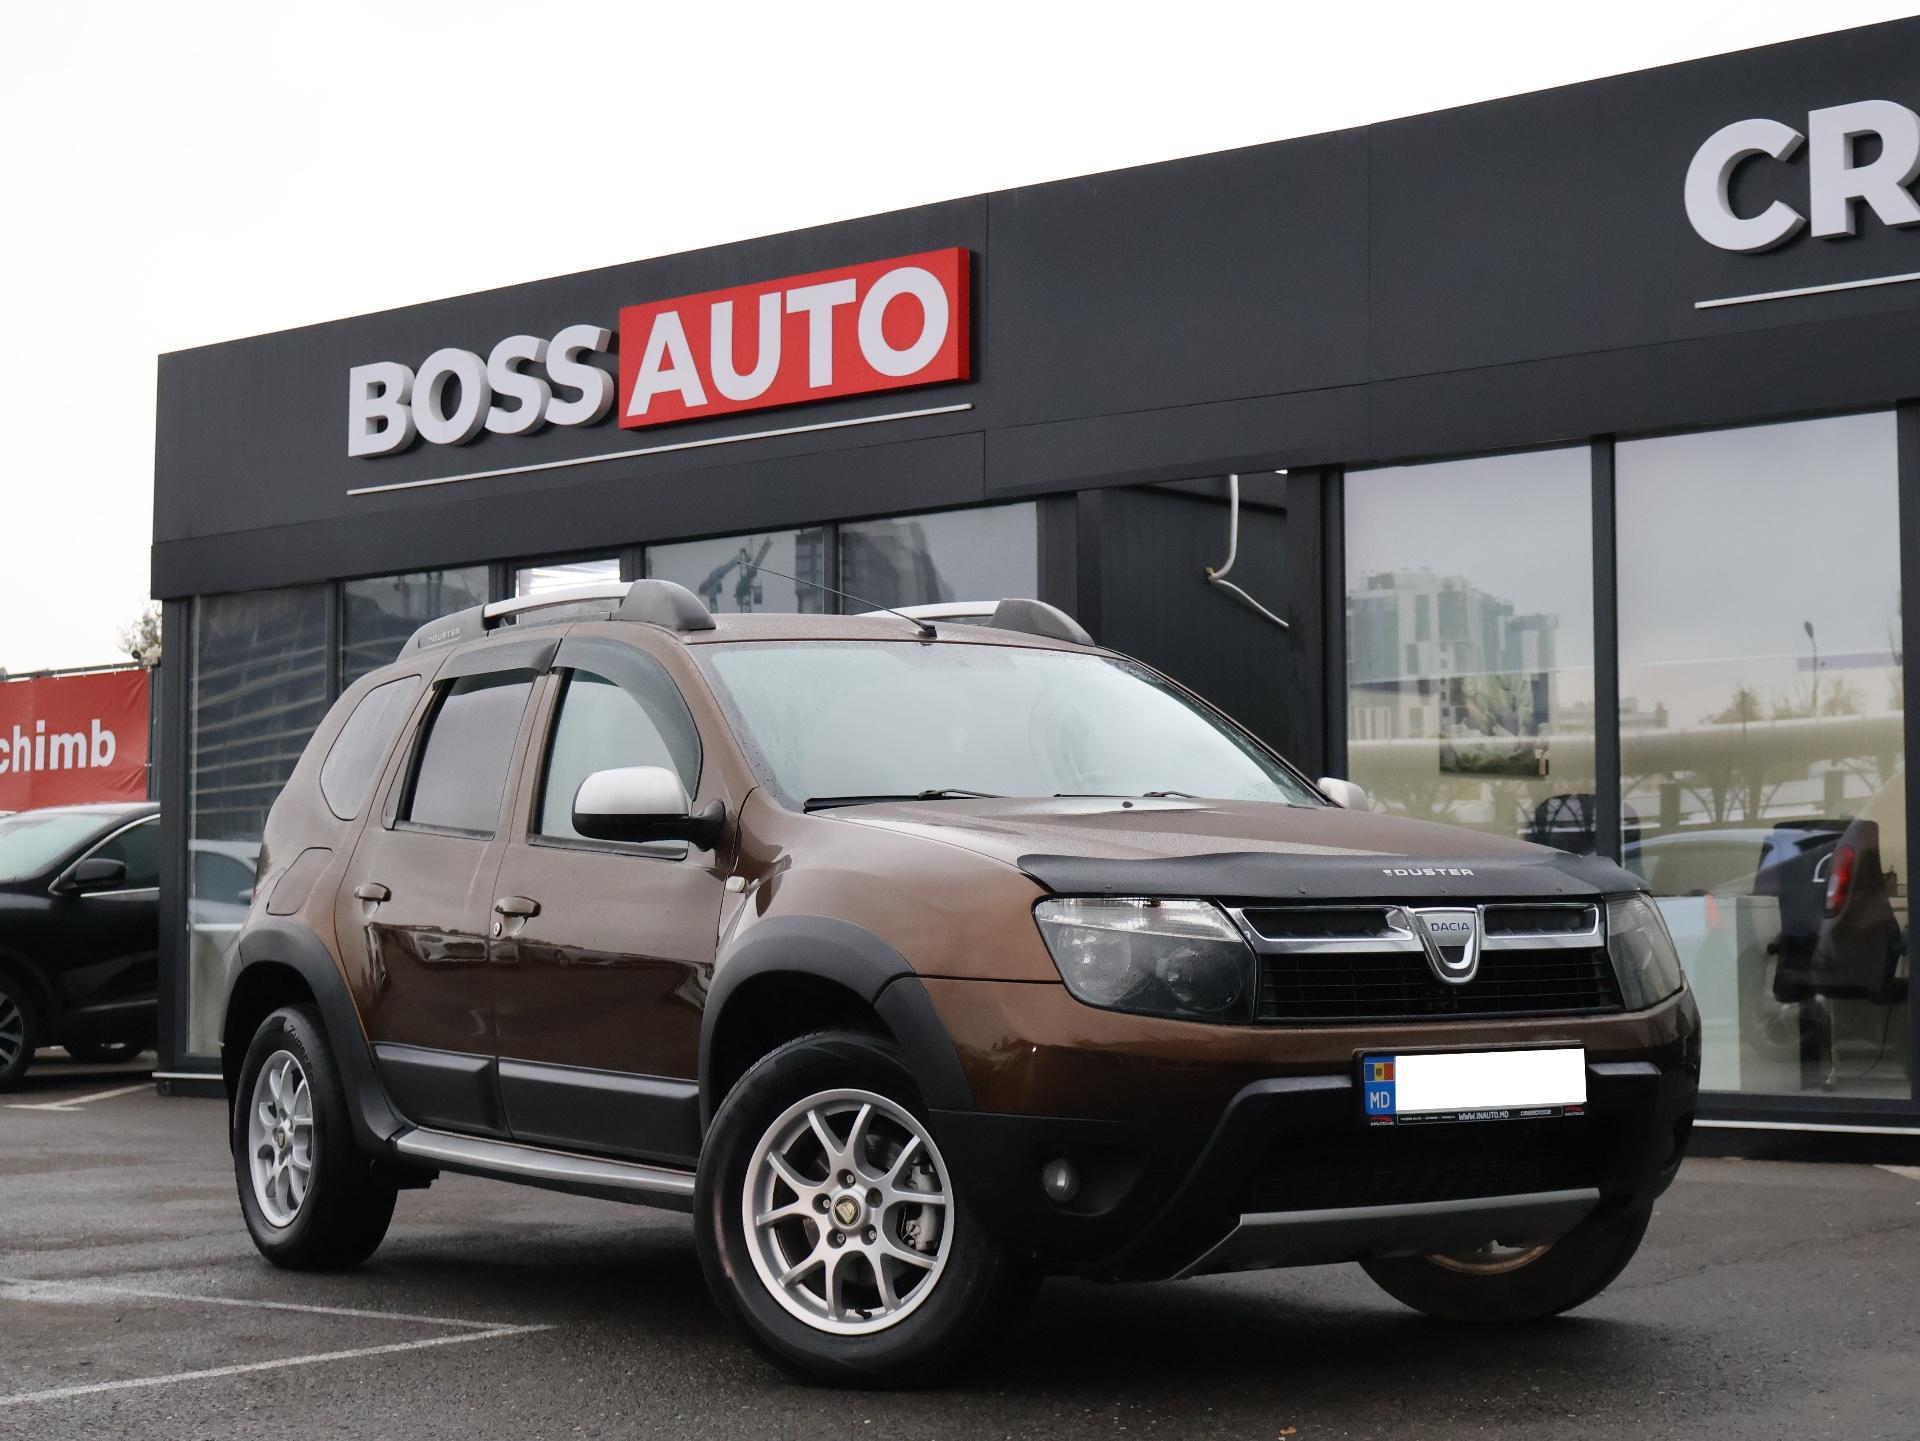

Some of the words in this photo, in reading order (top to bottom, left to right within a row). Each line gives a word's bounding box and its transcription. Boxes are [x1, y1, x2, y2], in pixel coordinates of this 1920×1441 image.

[1684, 100, 1920, 254] CR
[348, 324, 614, 459] BOSS
[626, 266, 949, 417] AUTO
[1395, 868, 1474, 876] DUSTER
[1431, 922, 1470, 932] DACIA
[1369, 1091, 1391, 1109] MD
